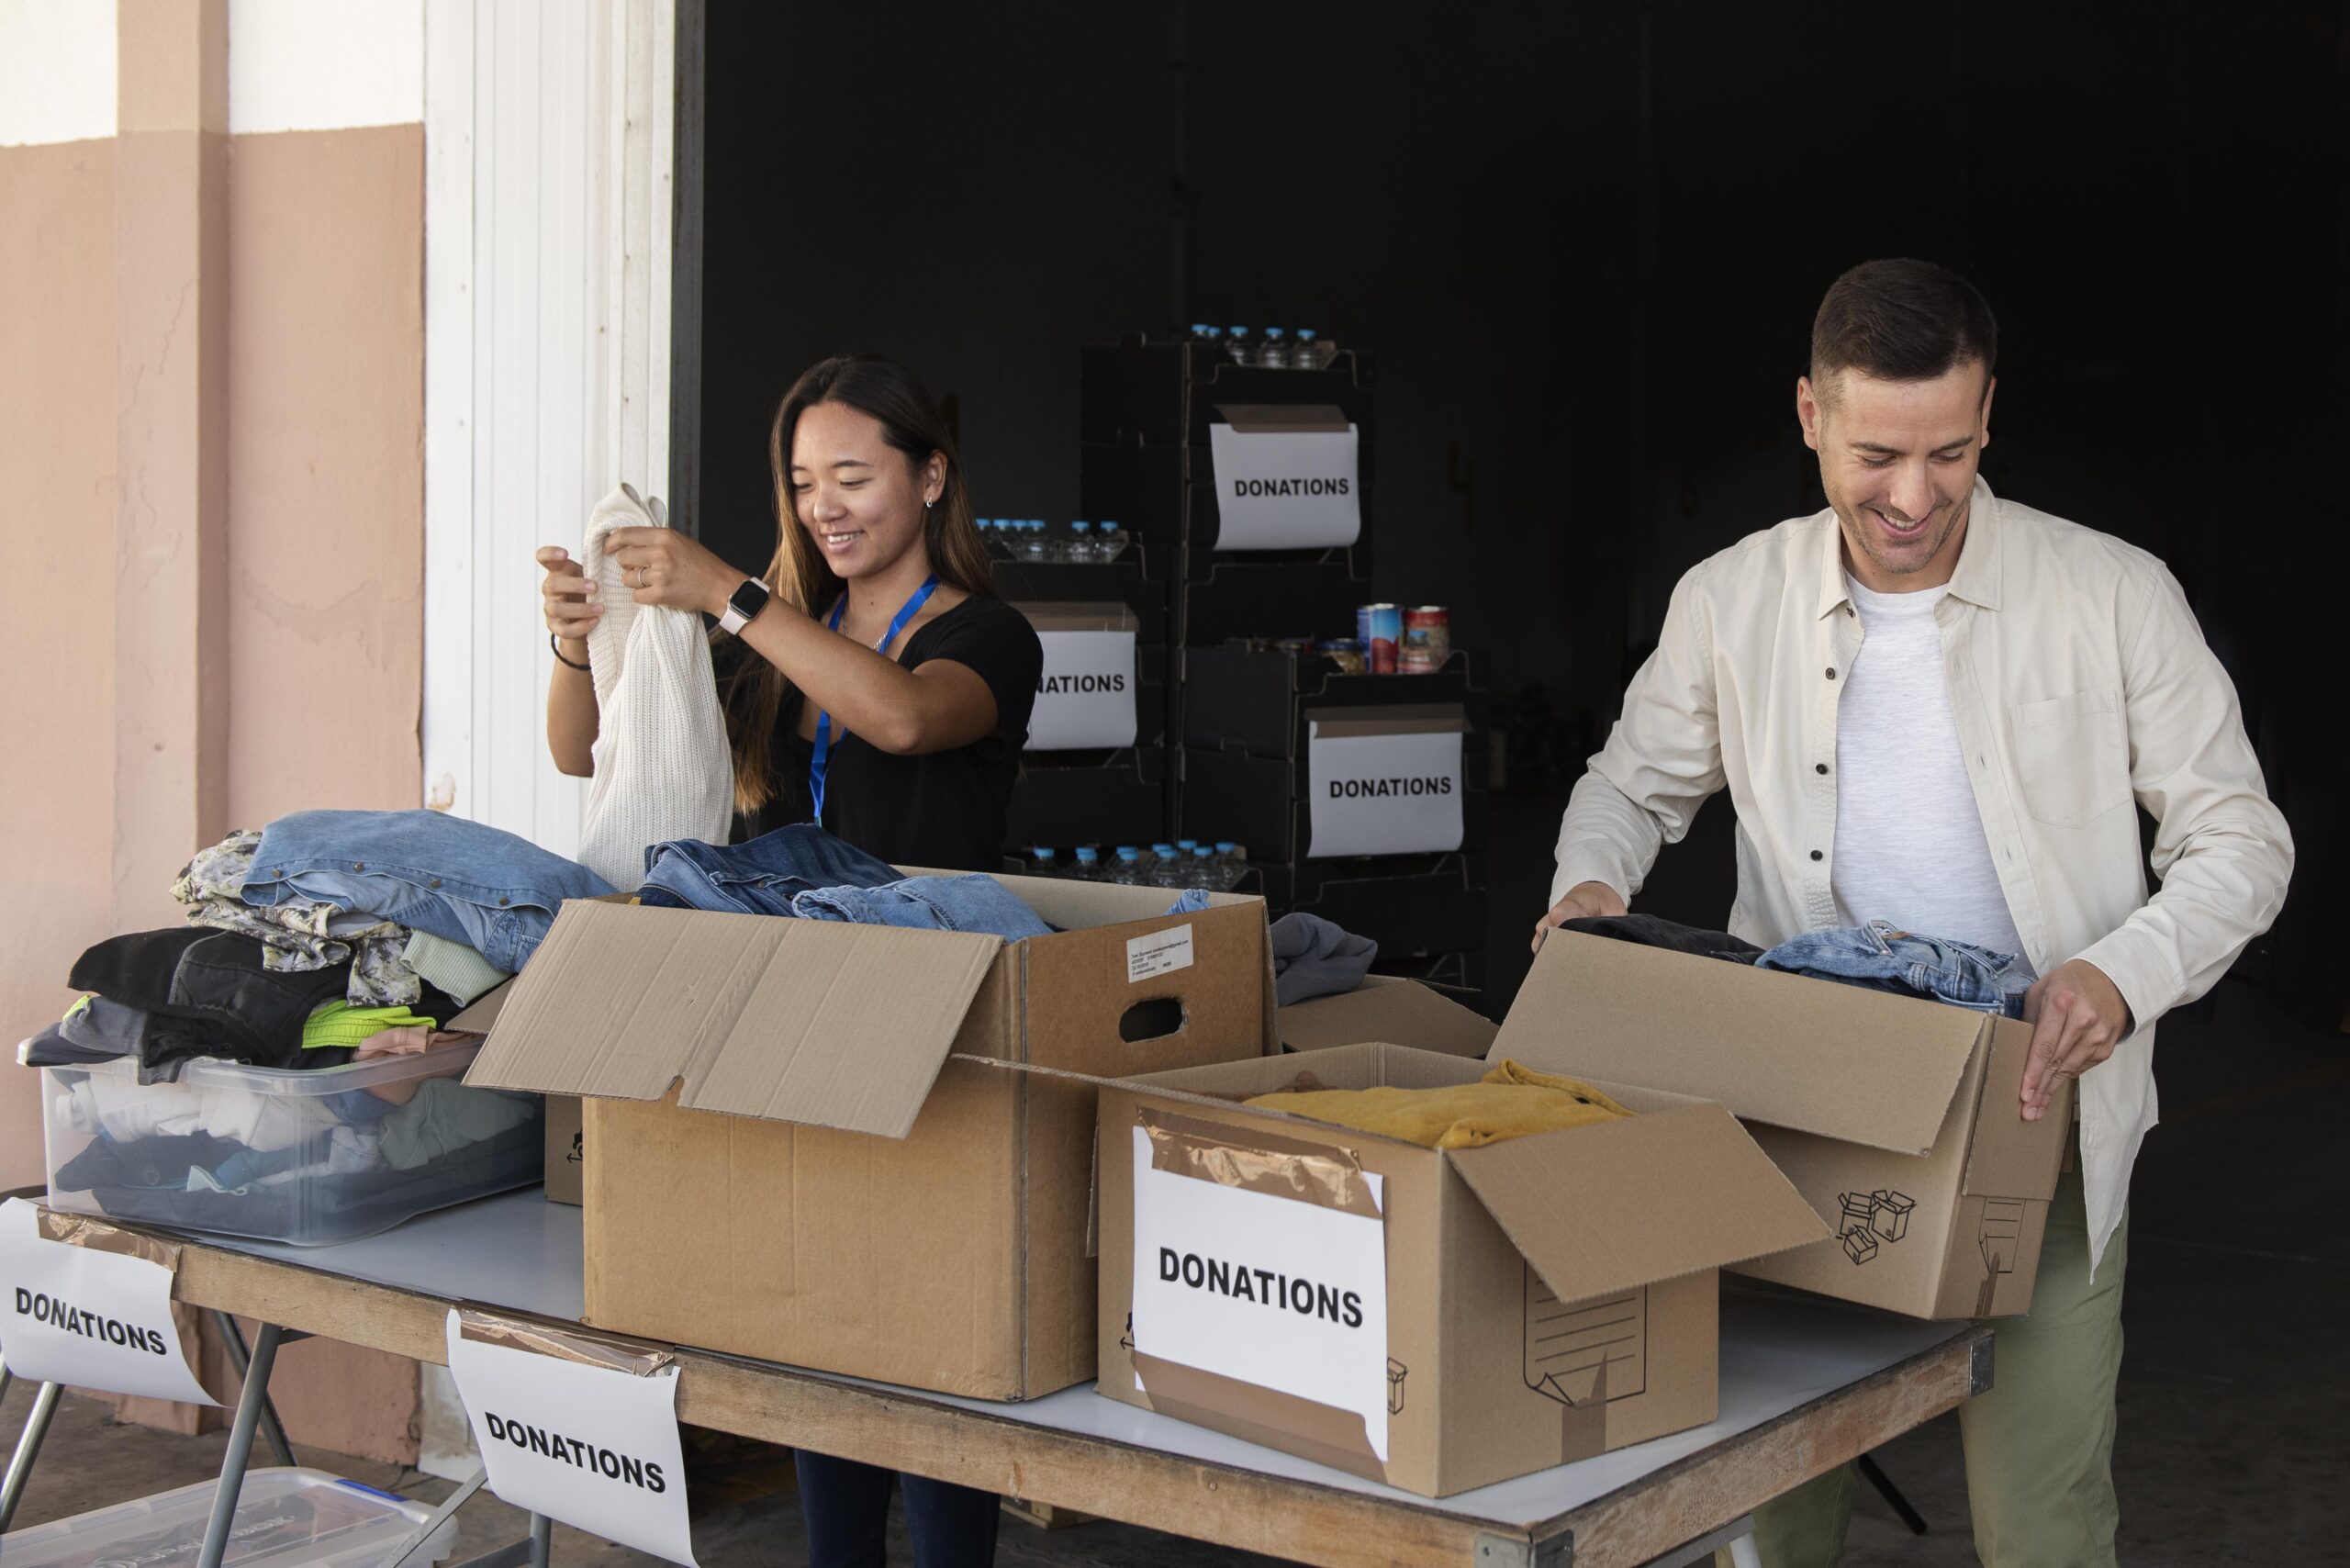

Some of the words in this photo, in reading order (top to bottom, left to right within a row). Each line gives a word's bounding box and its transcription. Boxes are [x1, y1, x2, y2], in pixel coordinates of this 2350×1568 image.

[1235, 477, 1349, 497] DONATIONS
[1329, 776, 1451, 799] DONATIONS
[16, 1286, 167, 1356] DONATIONS
[1159, 1247, 1363, 1328] DONATIONS
[484, 1411, 666, 1494] DONATIONS
